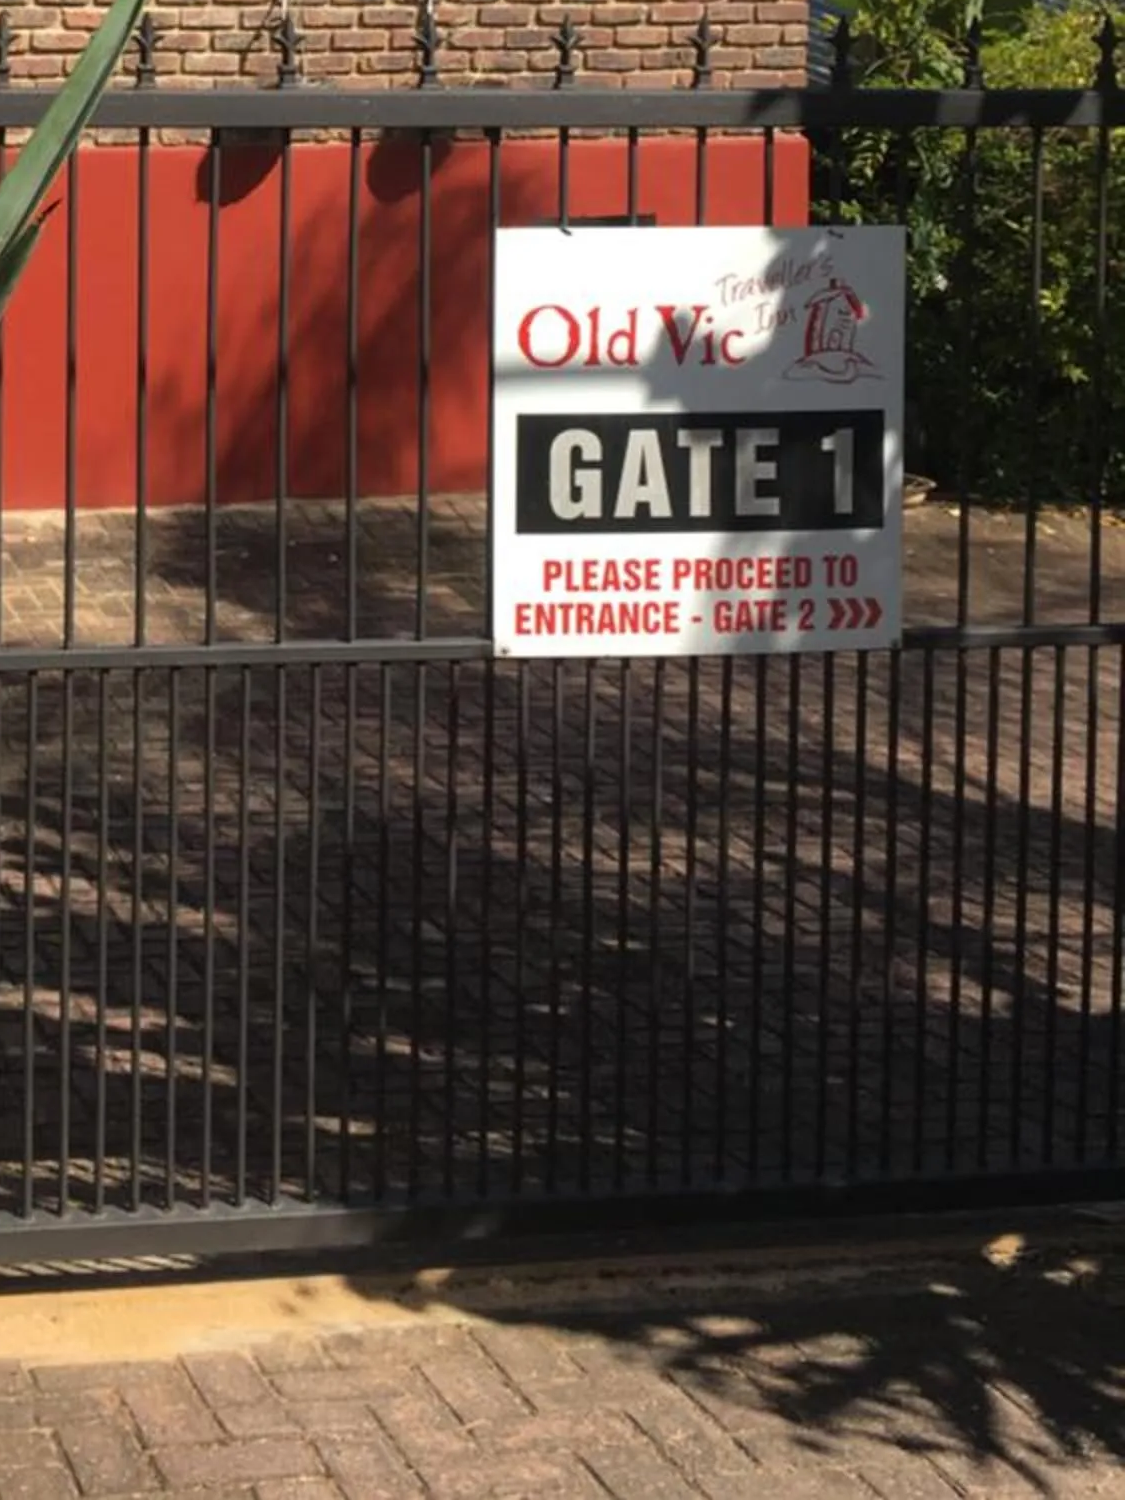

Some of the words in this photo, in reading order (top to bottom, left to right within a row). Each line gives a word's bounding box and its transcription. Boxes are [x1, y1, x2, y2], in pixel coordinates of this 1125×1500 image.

[518, 304, 639, 368] Old
[655, 304, 747, 367] Vic
[548, 426, 781, 520] GATE
[820, 427, 854, 516] 1
[542, 559, 661, 592] PLEASE
[672, 555, 812, 590] PROCEED
[823, 554, 859, 588] TO
[515, 601, 680, 636] ENTRANCE
[713, 599, 786, 634] GATE
[797, 598, 816, 631] 2
